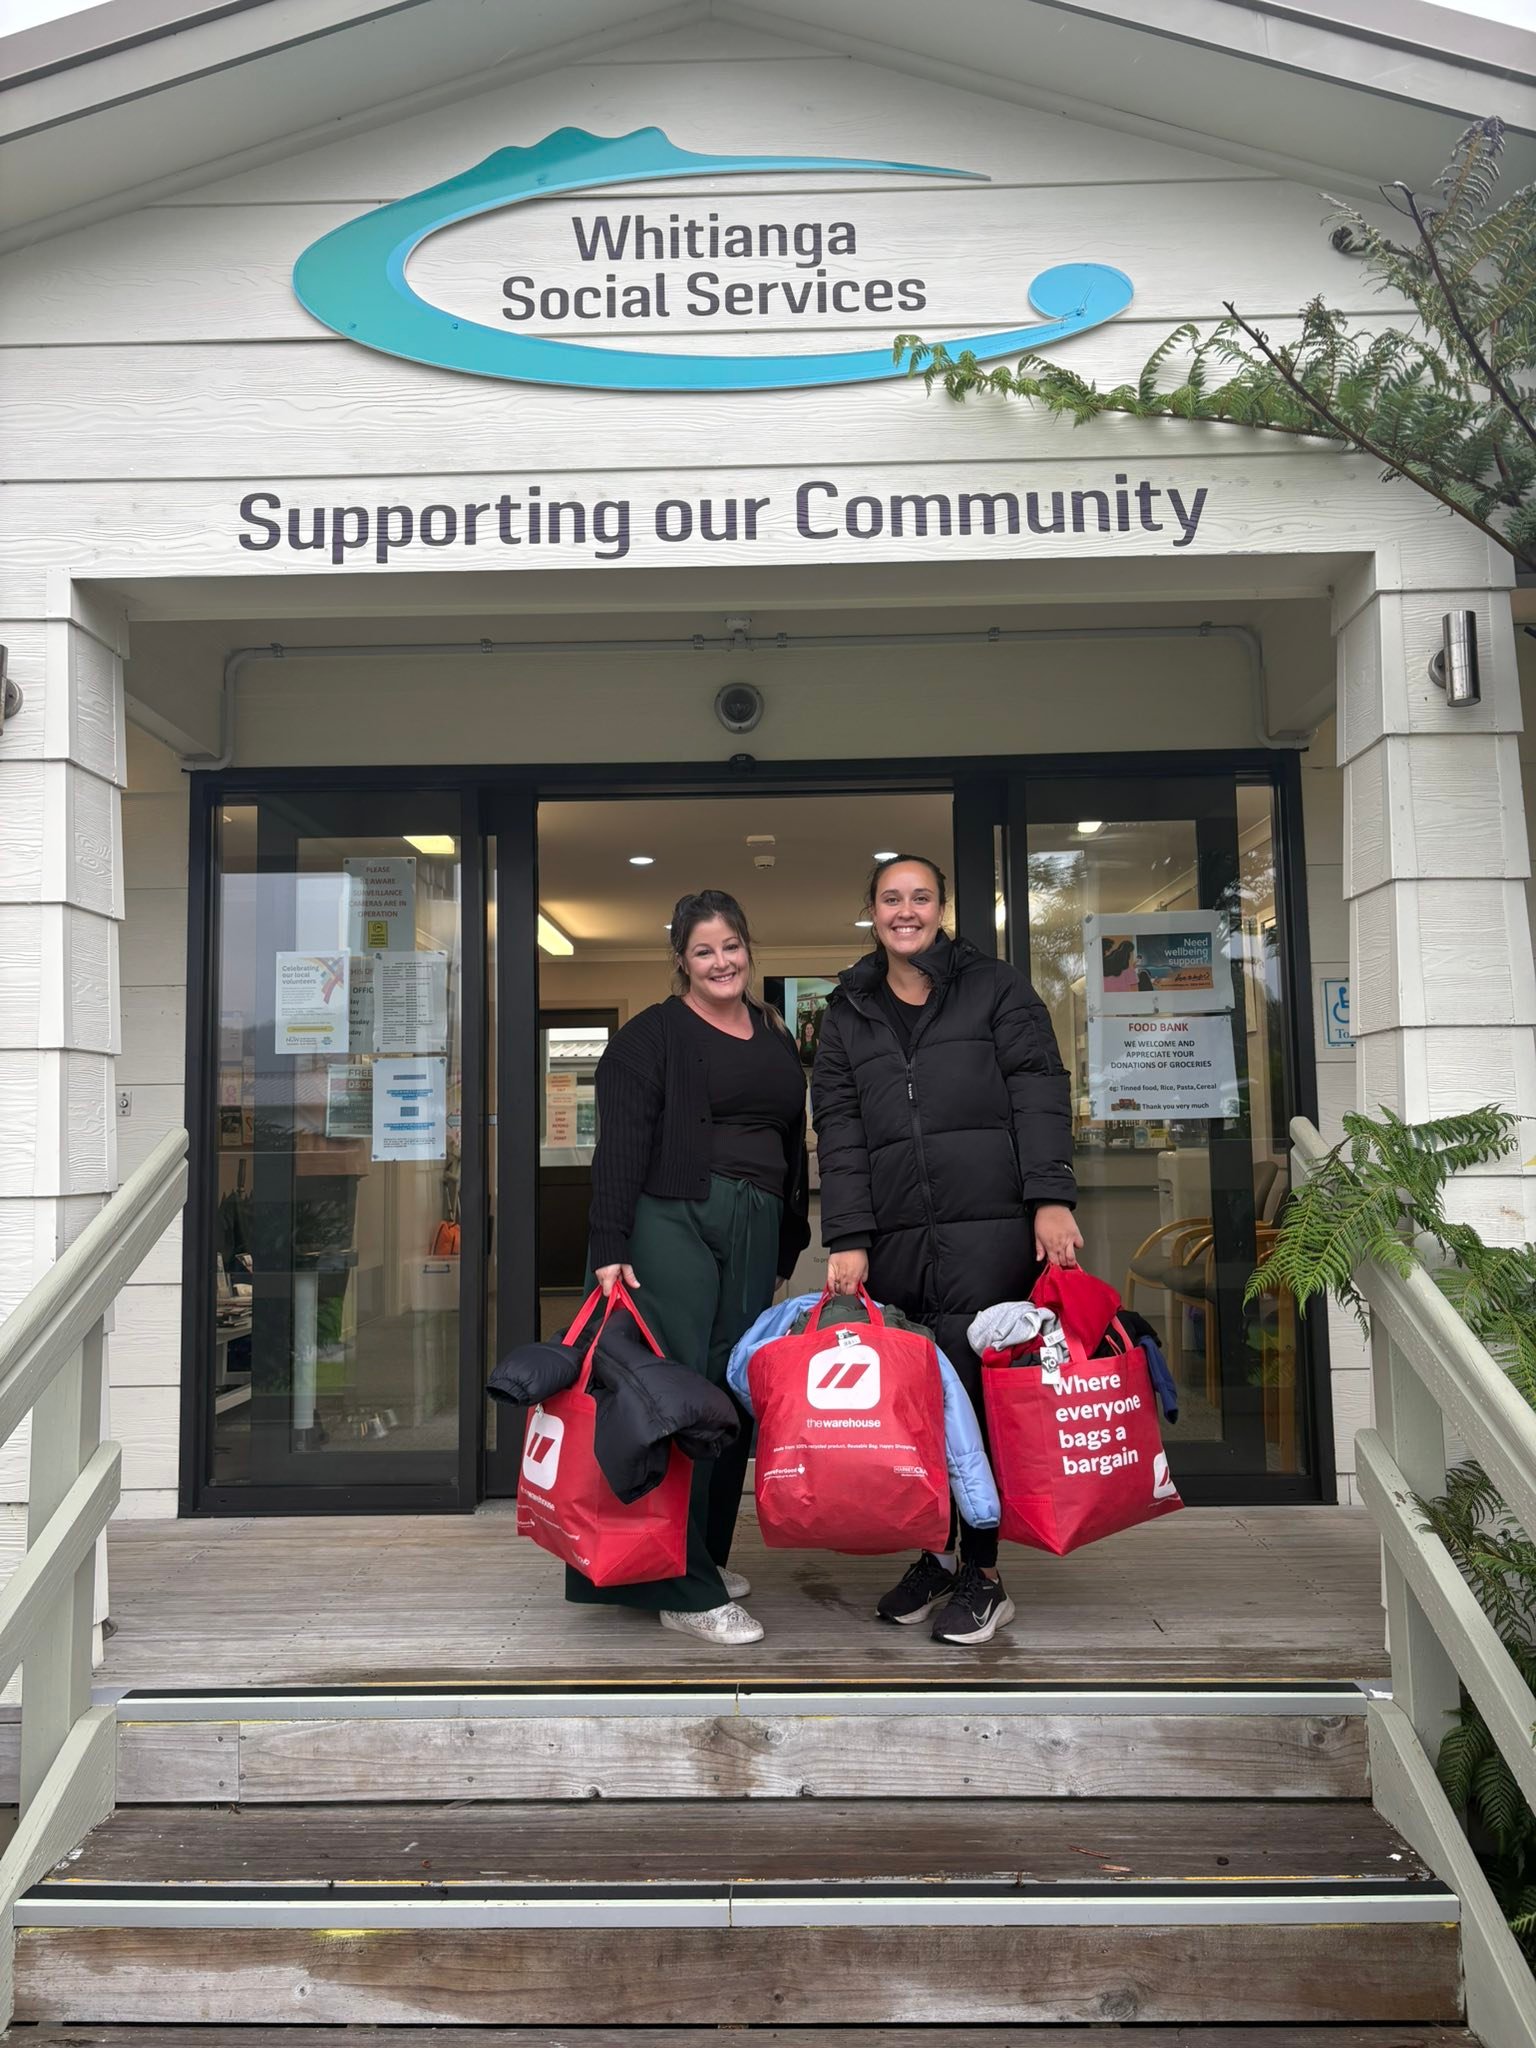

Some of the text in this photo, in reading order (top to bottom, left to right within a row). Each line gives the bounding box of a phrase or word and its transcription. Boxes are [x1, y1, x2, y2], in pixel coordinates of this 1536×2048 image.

[572, 214, 858, 269] Whitianga
[501, 265, 928, 320] Social Services
[238, 473, 1208, 565] Supporting our Community
[353, 889, 403, 897] SURVEILLANCE
[1183, 937, 1208, 947] Need
[1164, 947, 1208, 958] wellbeing
[1169, 956, 1208, 967] support?
[281, 965, 319, 973] Celebrating
[352, 986, 374, 994] OFFIC
[1128, 1022, 1189, 1032] FOOD BANK
[1124, 1040, 1136, 1048] WE
[1138, 1040, 1176, 1048] WELCOME
[1111, 1061, 1156, 1069] DONATIONS
[1169, 1060, 1212, 1068] GROCERIES
[1053, 1374, 1121, 1396] Where
[1055, 1394, 1141, 1422] everyone
[806, 1418, 881, 1429] thewarehouse
[1059, 1426, 1126, 1450] bags a
[1062, 1446, 1139, 1475] bargain
